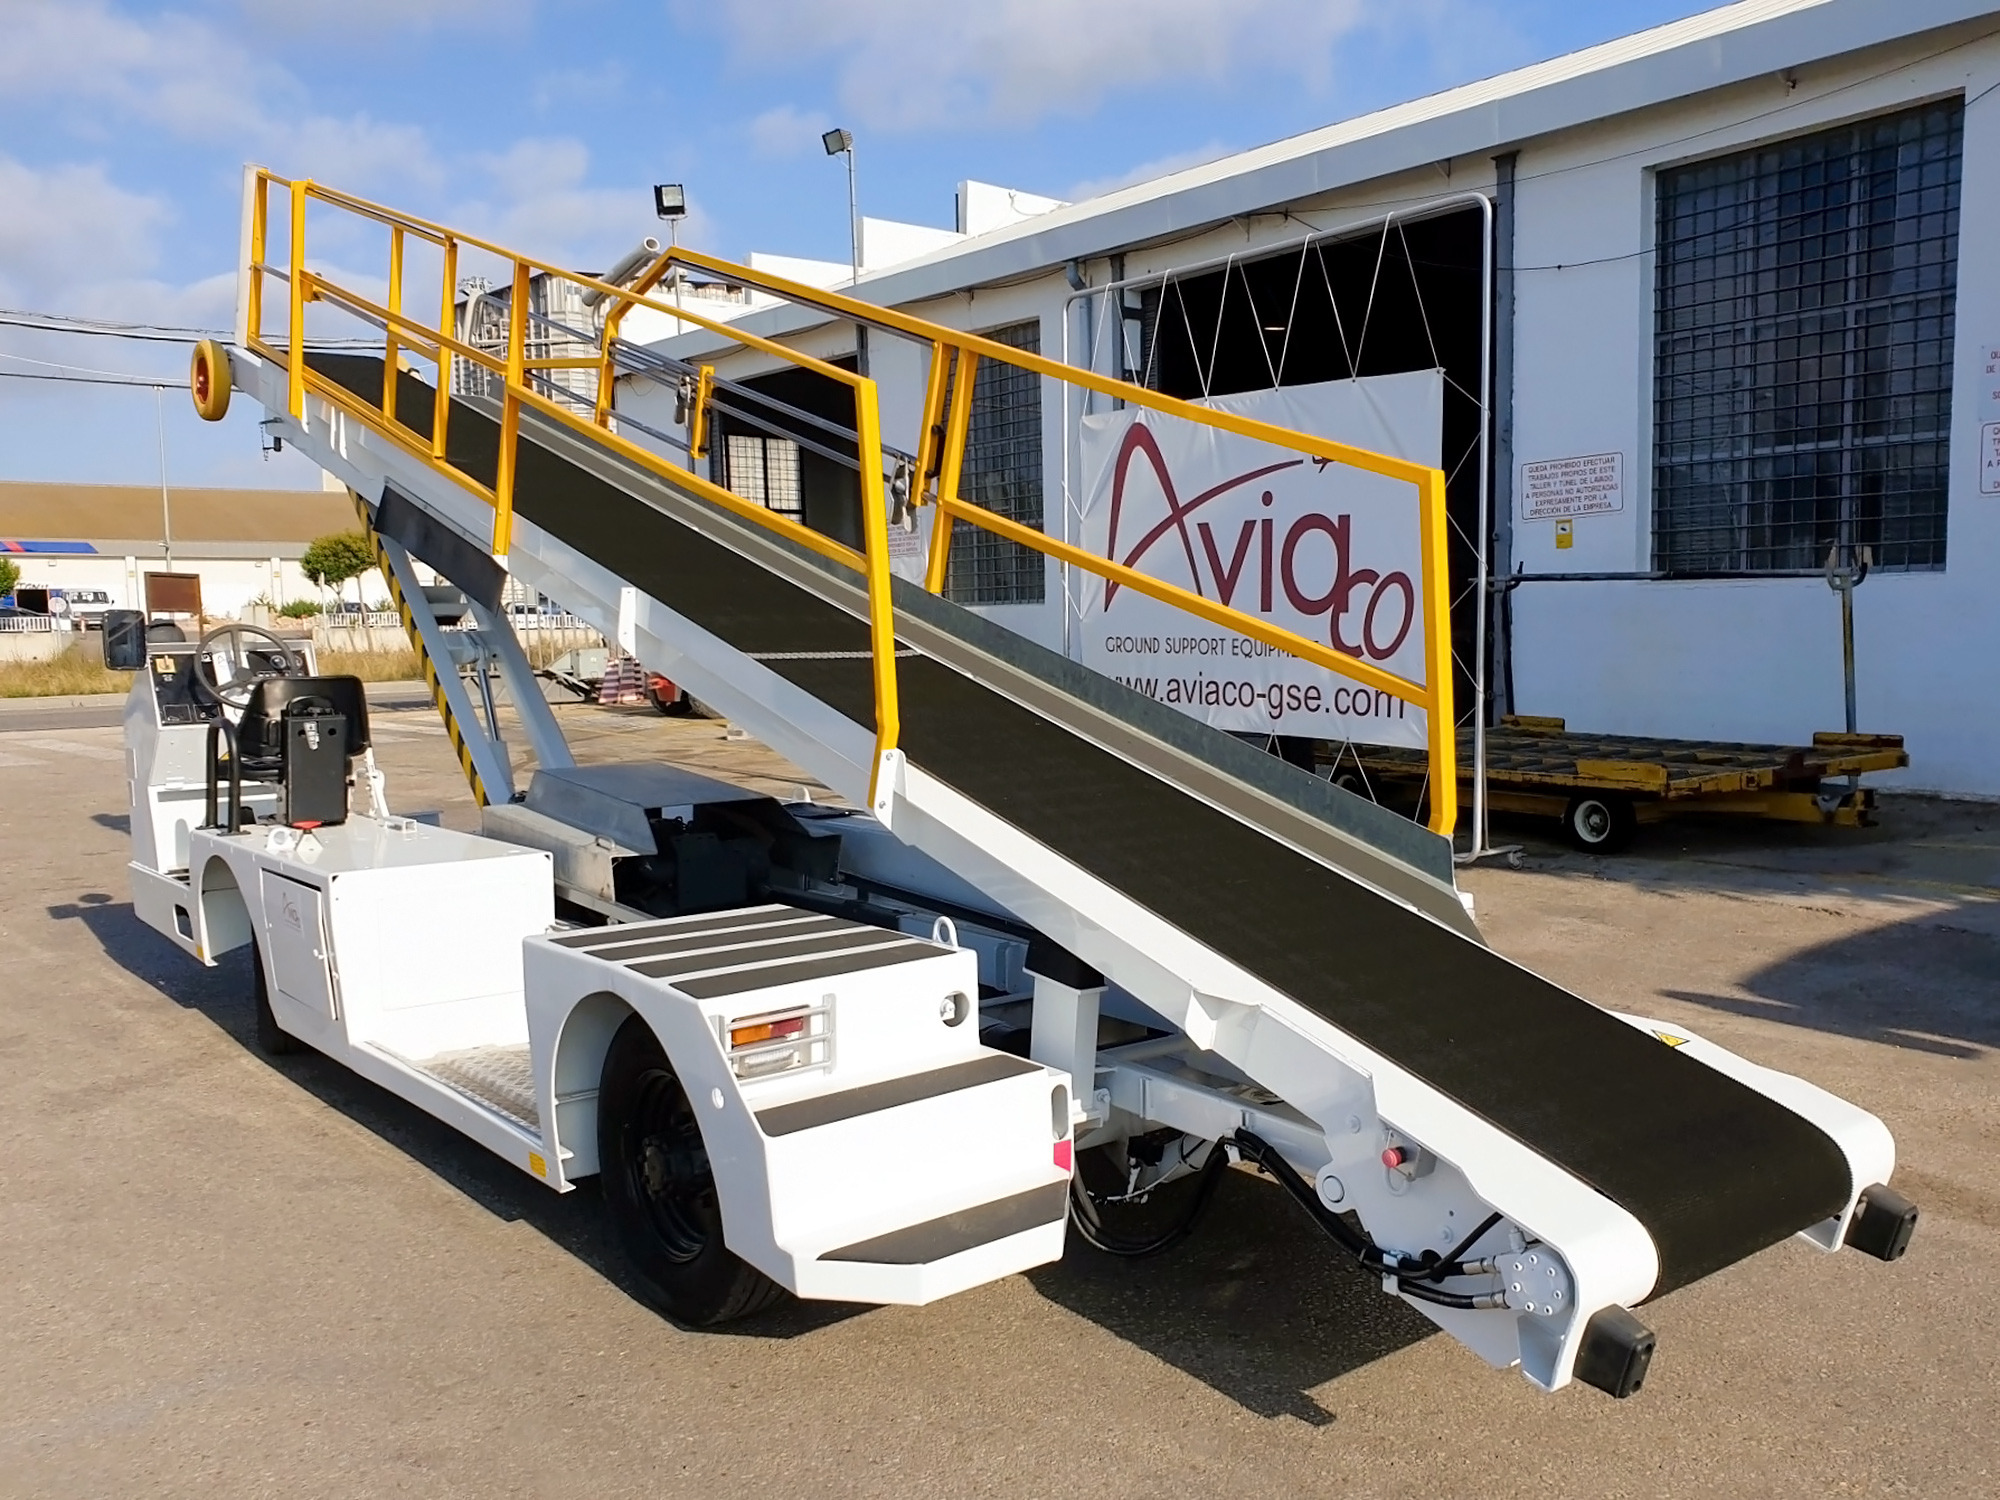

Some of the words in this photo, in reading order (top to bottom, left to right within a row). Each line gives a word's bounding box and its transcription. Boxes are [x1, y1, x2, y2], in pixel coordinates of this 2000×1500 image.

[1528, 464, 1548, 473] QUEDA
[1550, 461, 1581, 471] PROHIBIDO
[1583, 456, 1615, 467] EFECTUAR
[1528, 472, 1559, 481] TRABAJOS
[1561, 469, 1588, 478] PROPIOS
[1589, 467, 1597, 475] DE
[1599, 465, 1615, 474] ESTE
[1530, 481, 1551, 490] TALLER
[1580, 477, 1588, 485] DE
[1532, 490, 1563, 499] PERSONAS
[1576, 483, 1619, 493] AUTORIZADAS
[1535, 496, 1582, 507] EXPRESAMENTE
[1584, 494, 1597, 502] POR
[1599, 493, 1607, 501] LA
[1564, 505, 1571, 513] DE
[1583, 502, 1611, 511] EMPRESA
[1105, 635, 1160, 654] GROUND
[1164, 637, 1226, 656] SUPPORT
